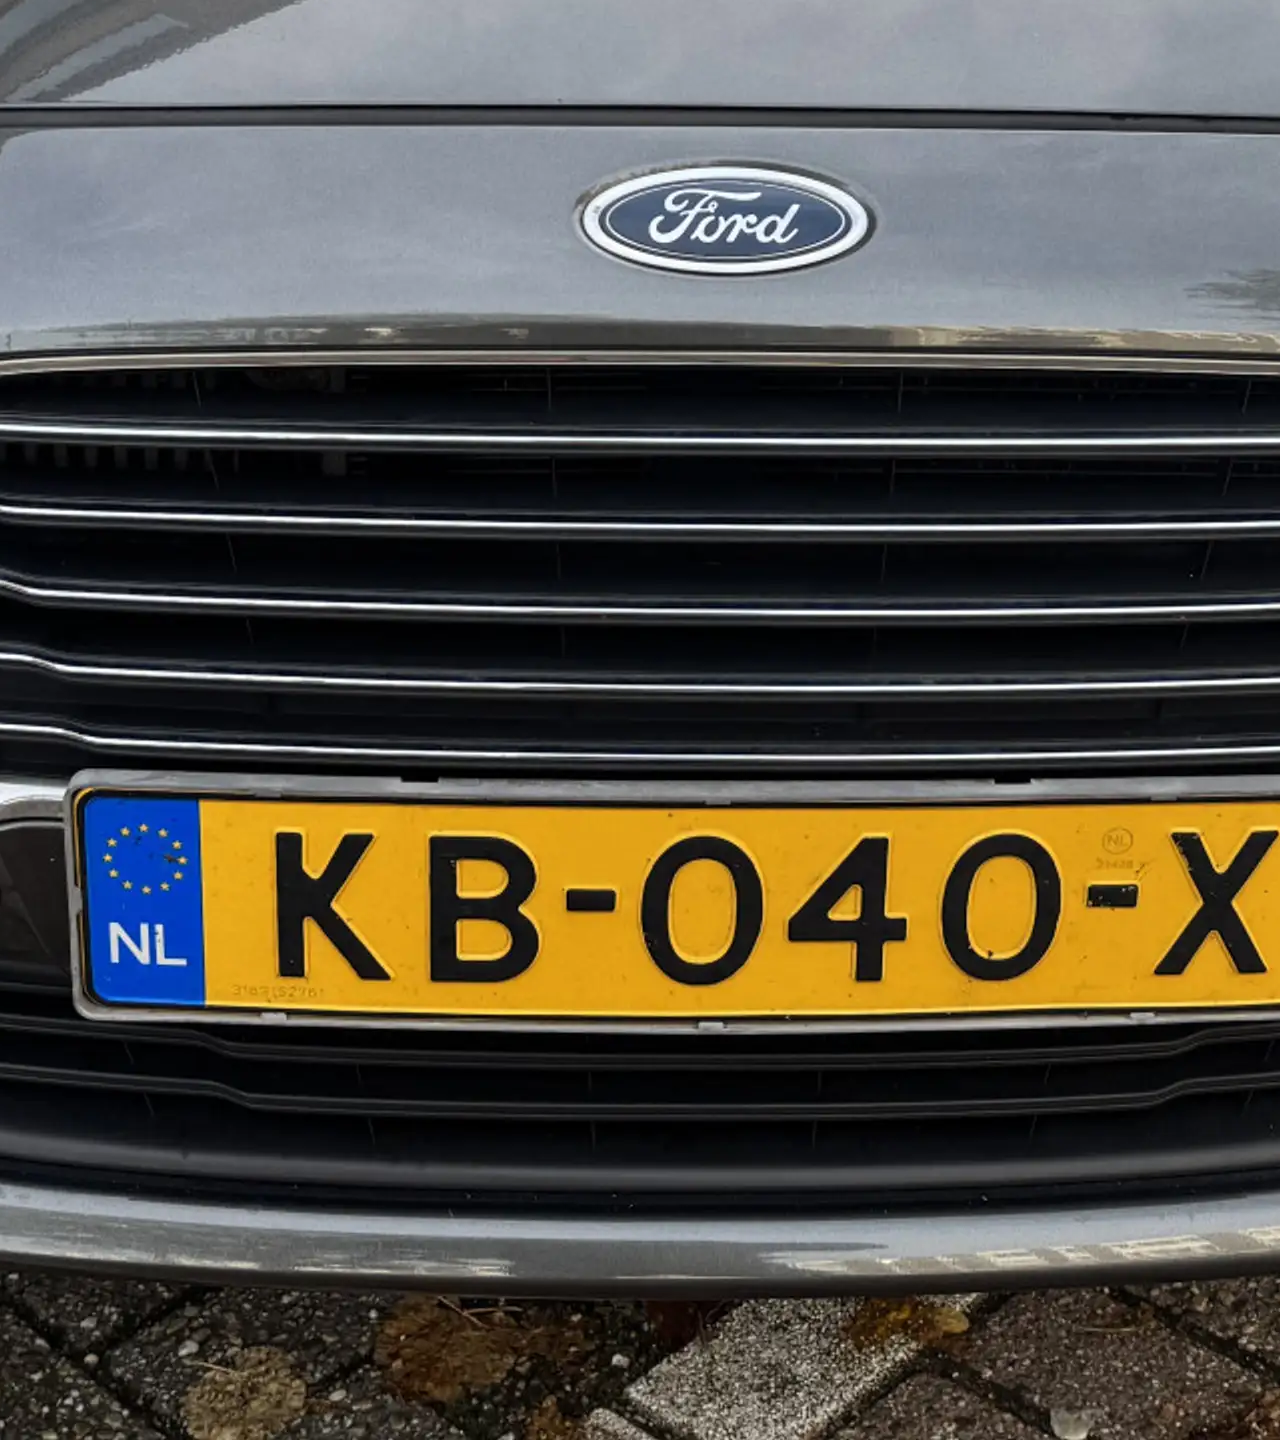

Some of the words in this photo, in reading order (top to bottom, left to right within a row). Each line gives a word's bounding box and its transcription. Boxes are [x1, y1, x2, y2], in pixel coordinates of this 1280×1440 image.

[648, 188, 800, 243] Ford
[275, 827, 1280, 986] KB-040-X
[108, 922, 188, 966] NL
